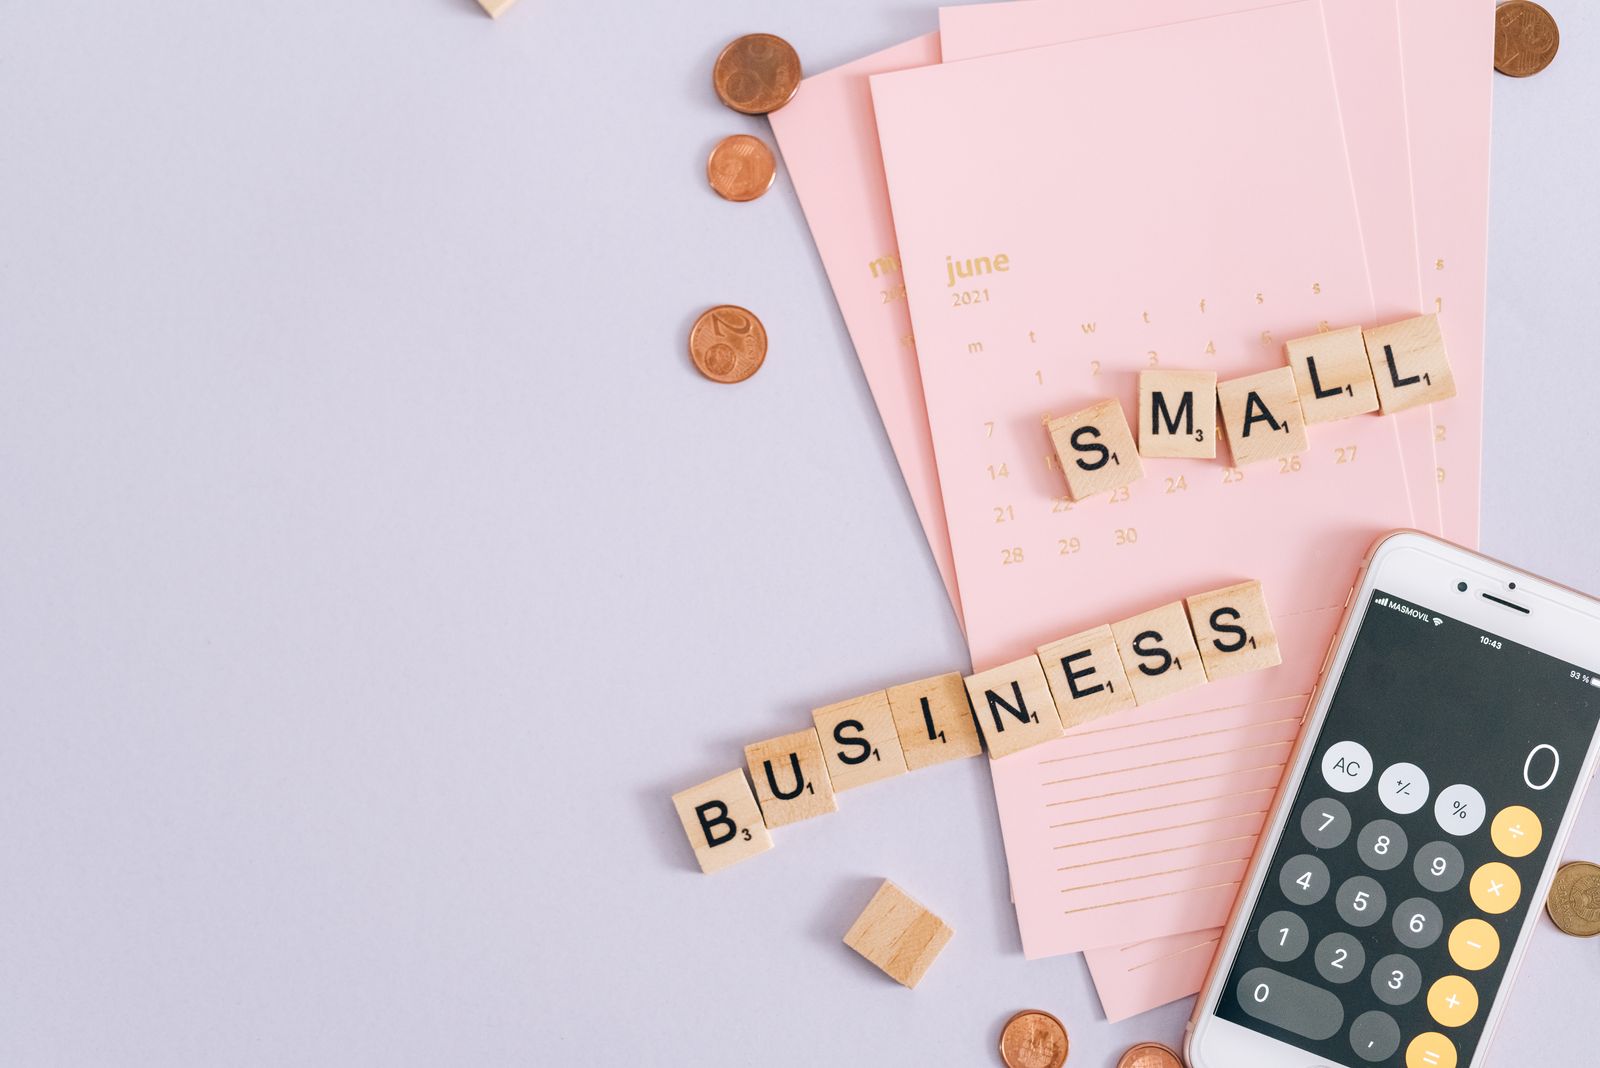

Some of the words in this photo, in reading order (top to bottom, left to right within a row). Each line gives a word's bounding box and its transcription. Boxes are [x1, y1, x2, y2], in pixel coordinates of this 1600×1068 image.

[946, 253, 1009, 287] june
[952, 288, 990, 306] 2021
[968, 341, 983, 353] m
[1028, 331, 1036, 343] t
[1082, 322, 1096, 334] w
[1143, 311, 1151, 323] t
[1035, 370, 1043, 385] 1
[1091, 361, 1102, 376] 2
[1148, 351, 1158, 367] 3
[984, 421, 994, 437] 7
[987, 462, 1009, 480] 14
[993, 504, 1014, 523] 21
[1109, 486, 1130, 504] 23
[1165, 475, 1187, 493] 24
[1279, 456, 1301, 473] 26
[1335, 446, 1357, 464] 27
[1001, 547, 1024, 565] 28
[1059, 537, 1080, 555] 29
[1115, 528, 1137, 545] 30
[1388, 600, 1429, 623] MASMOVIL
[1479, 635, 1502, 650] 10:43
[1570, 670, 1581, 681] 93
[1523, 743, 1560, 791] 0
[1333, 756, 1361, 777] AC
[1453, 800, 1467, 819] %
[1317, 812, 1335, 832] 7
[1374, 836, 1391, 855] 8
[1430, 857, 1447, 876] 9
[1296, 871, 1313, 890] 4
[1353, 891, 1370, 911] 5
[1409, 913, 1426, 933] 6
[1278, 927, 1290, 946] 1
[1331, 949, 1348, 969] 2
[1388, 970, 1404, 990] 3
[1254, 983, 1270, 1003] 0
